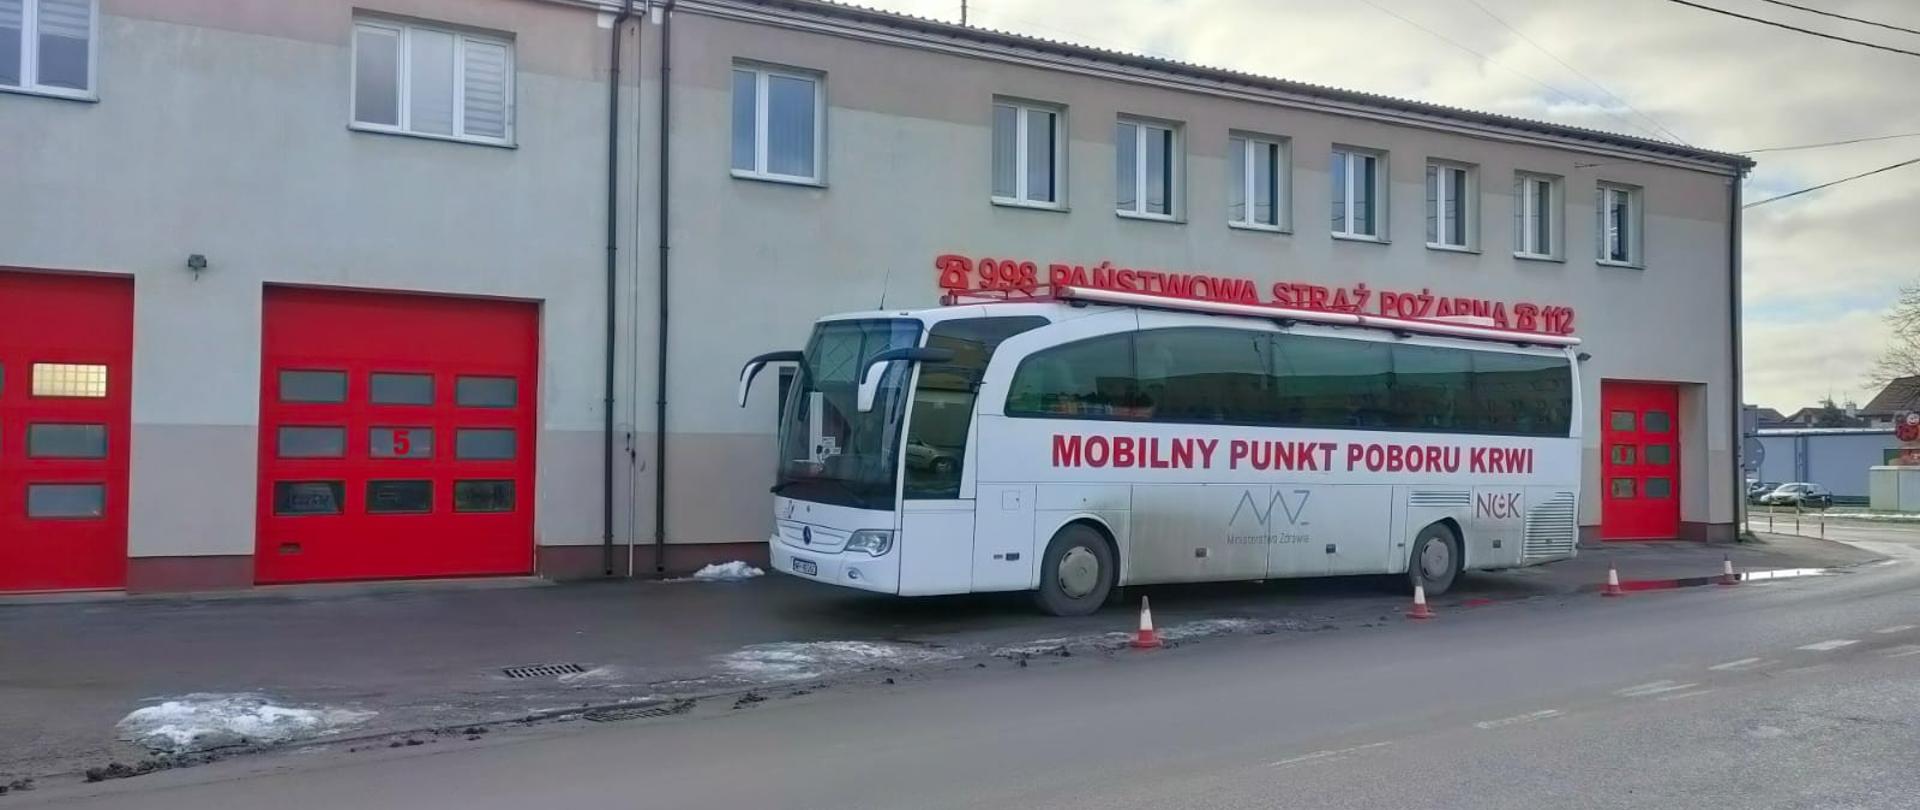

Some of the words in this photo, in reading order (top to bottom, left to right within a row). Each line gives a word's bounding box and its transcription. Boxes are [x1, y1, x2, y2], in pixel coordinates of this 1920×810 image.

[978, 258, 1037, 291] 998
[1049, 261, 1259, 303] PAŃSTWOWA
[1273, 282, 1371, 312] STRAŻ
[1380, 288, 1510, 327] POŻARNA
[1542, 305, 1575, 333] 112
[392, 430, 410, 455] 5
[1052, 435, 1218, 467] MOBILNY
[1231, 440, 1338, 469] PUNKT
[1347, 444, 1461, 472] POBORU
[1469, 447, 1533, 473] KRWI
